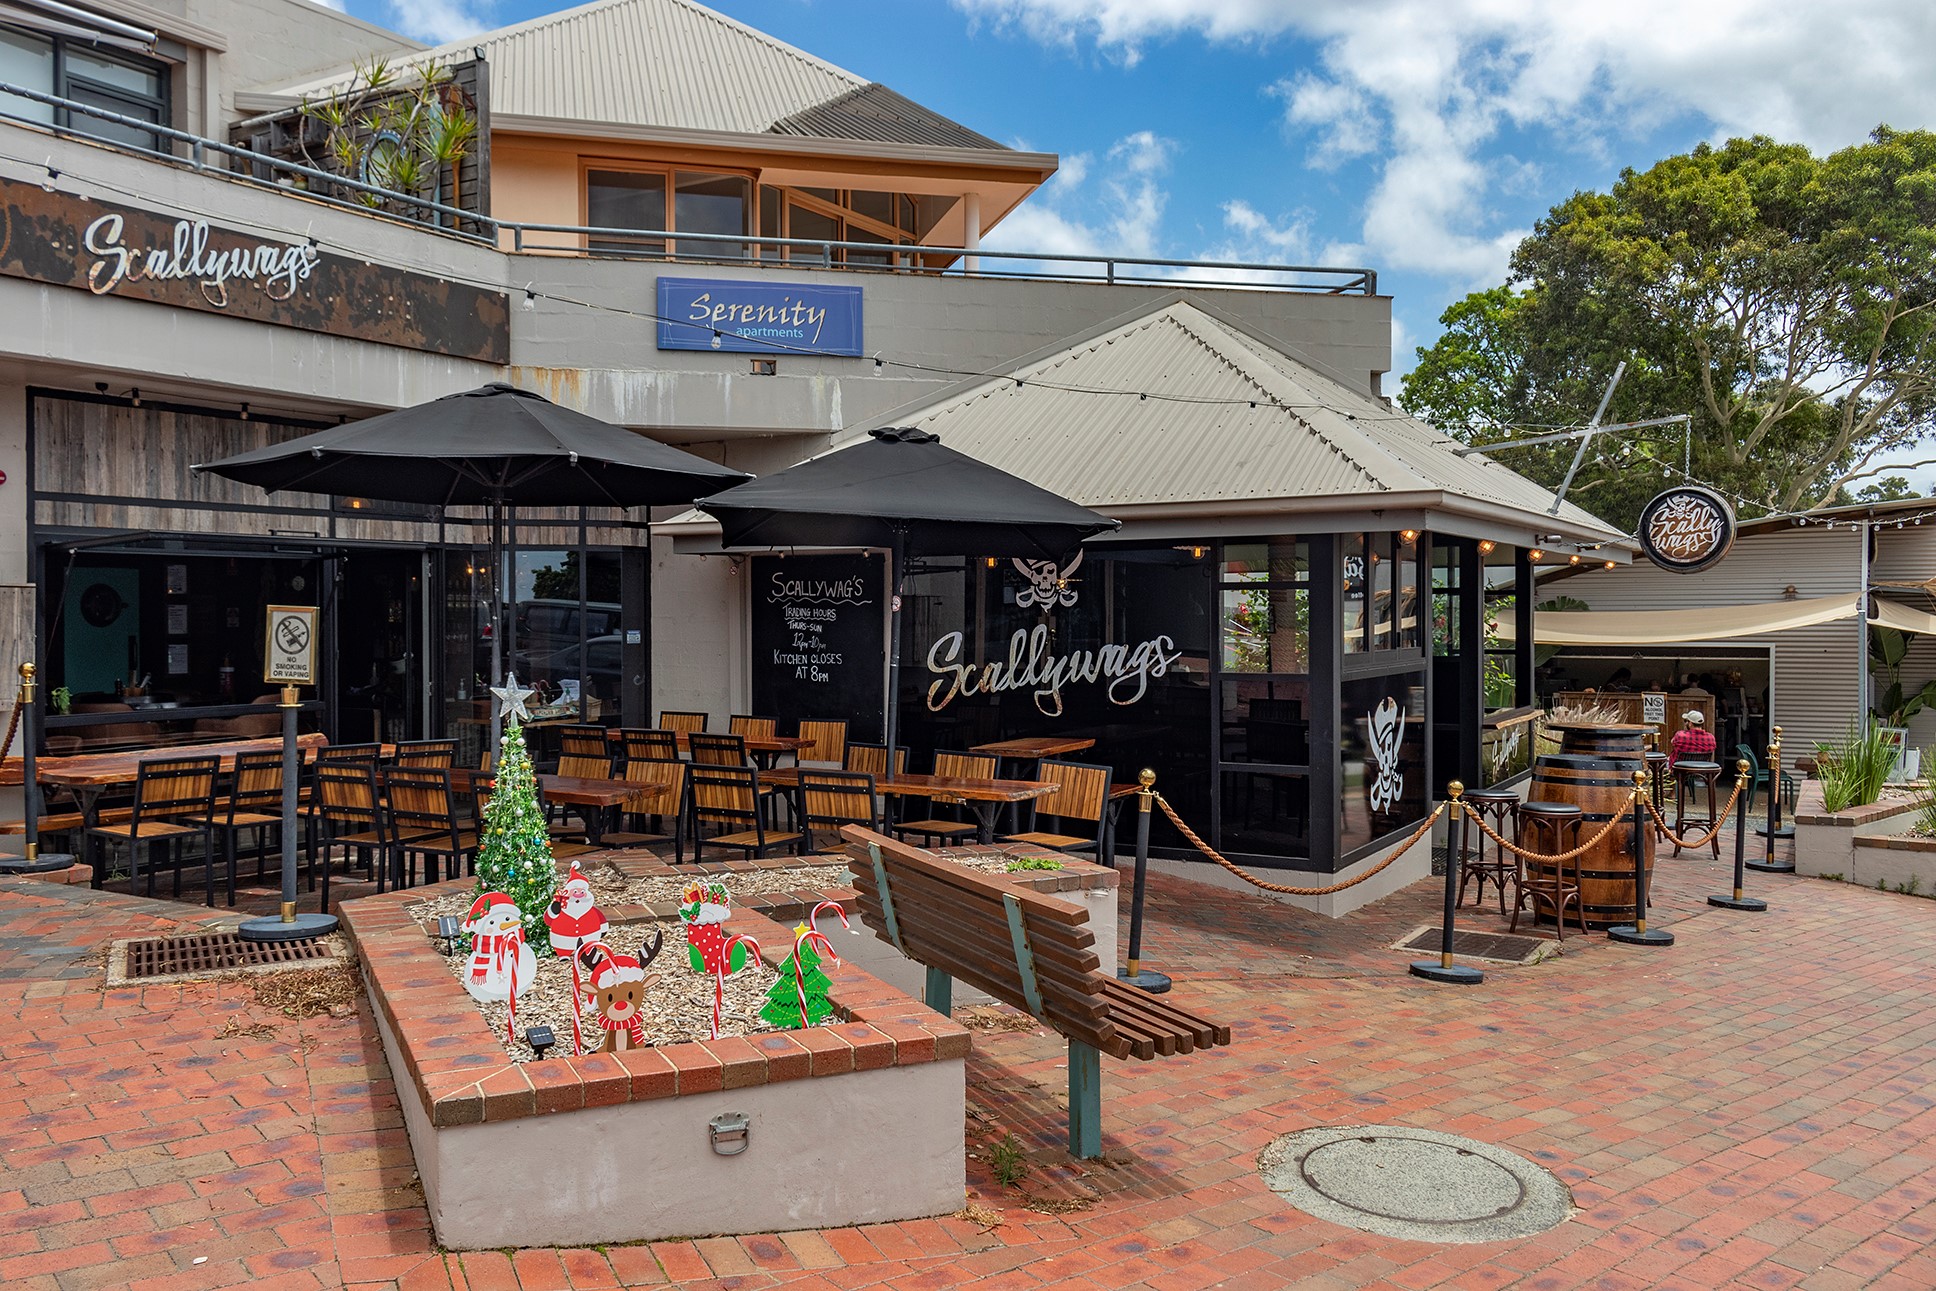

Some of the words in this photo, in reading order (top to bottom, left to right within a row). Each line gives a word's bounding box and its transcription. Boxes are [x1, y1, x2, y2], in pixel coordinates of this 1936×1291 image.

[84, 213, 321, 307] Scallywags
[689, 292, 826, 344] Serenity
[736, 325, 804, 339] apartments
[1650, 505, 1724, 543] Scally
[1655, 531, 1708, 558] wags
[771, 572, 864, 598] SCALLYWAG'S
[782, 602, 811, 618] TRADING
[812, 608, 837, 619] HOURS
[787, 620, 823, 632] THURS-SUN
[275, 663, 307, 671] SMOKING
[773, 648, 808, 665] KITCHEN
[810, 653, 843, 665] CLOSES
[795, 665, 808, 679] AT
[926, 623, 1183, 717] Scallywags
